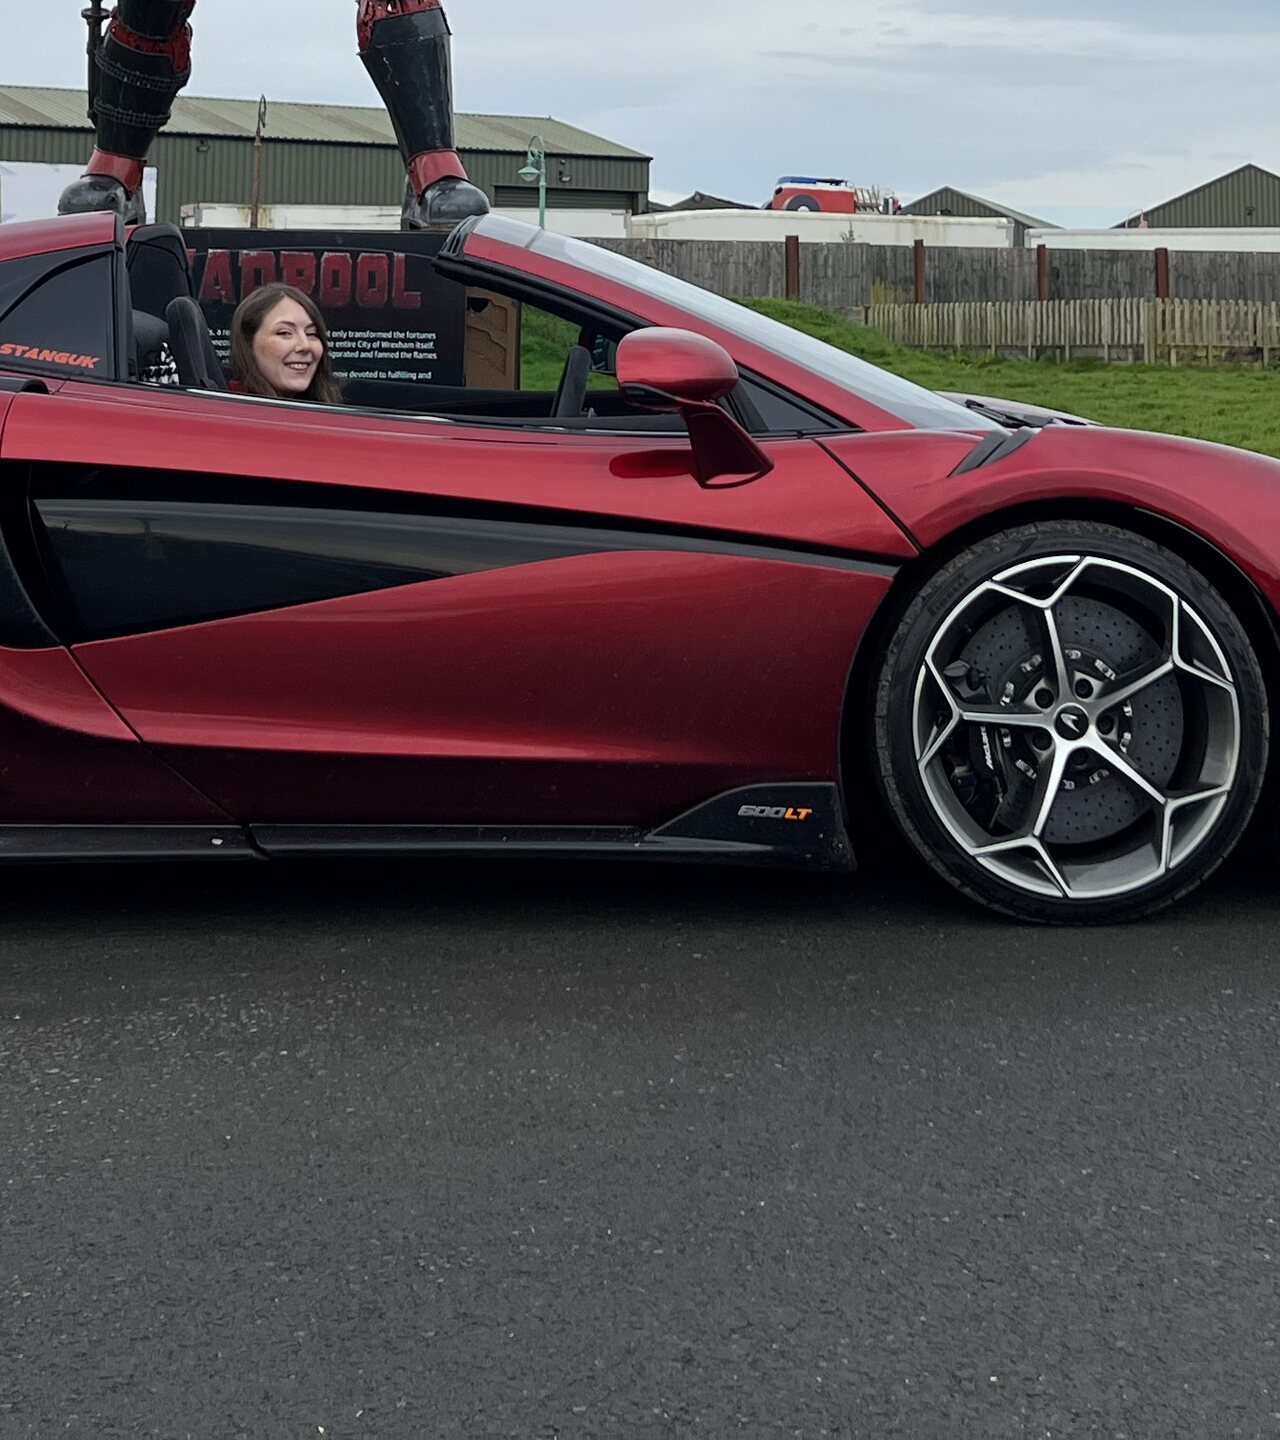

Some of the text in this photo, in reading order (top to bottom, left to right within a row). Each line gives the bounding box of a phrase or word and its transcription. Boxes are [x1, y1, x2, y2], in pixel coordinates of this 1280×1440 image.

[187, 248, 422, 309] ADPOOL
[331, 330, 348, 339] only
[348, 329, 392, 339] transformed
[393, 330, 405, 339] the
[406, 330, 437, 340] fortunes
[335, 340, 356, 349] entire
[357, 340, 371, 349] City
[372, 340, 380, 349] of
[381, 340, 414, 349] Wrexham
[360, 350, 373, 359] and
[374, 350, 400, 359] fanned
[400, 350, 412, 359] the
[348, 370, 378, 379] devoted
[379, 370, 387, 379] to
[417, 371, 432, 379] and
